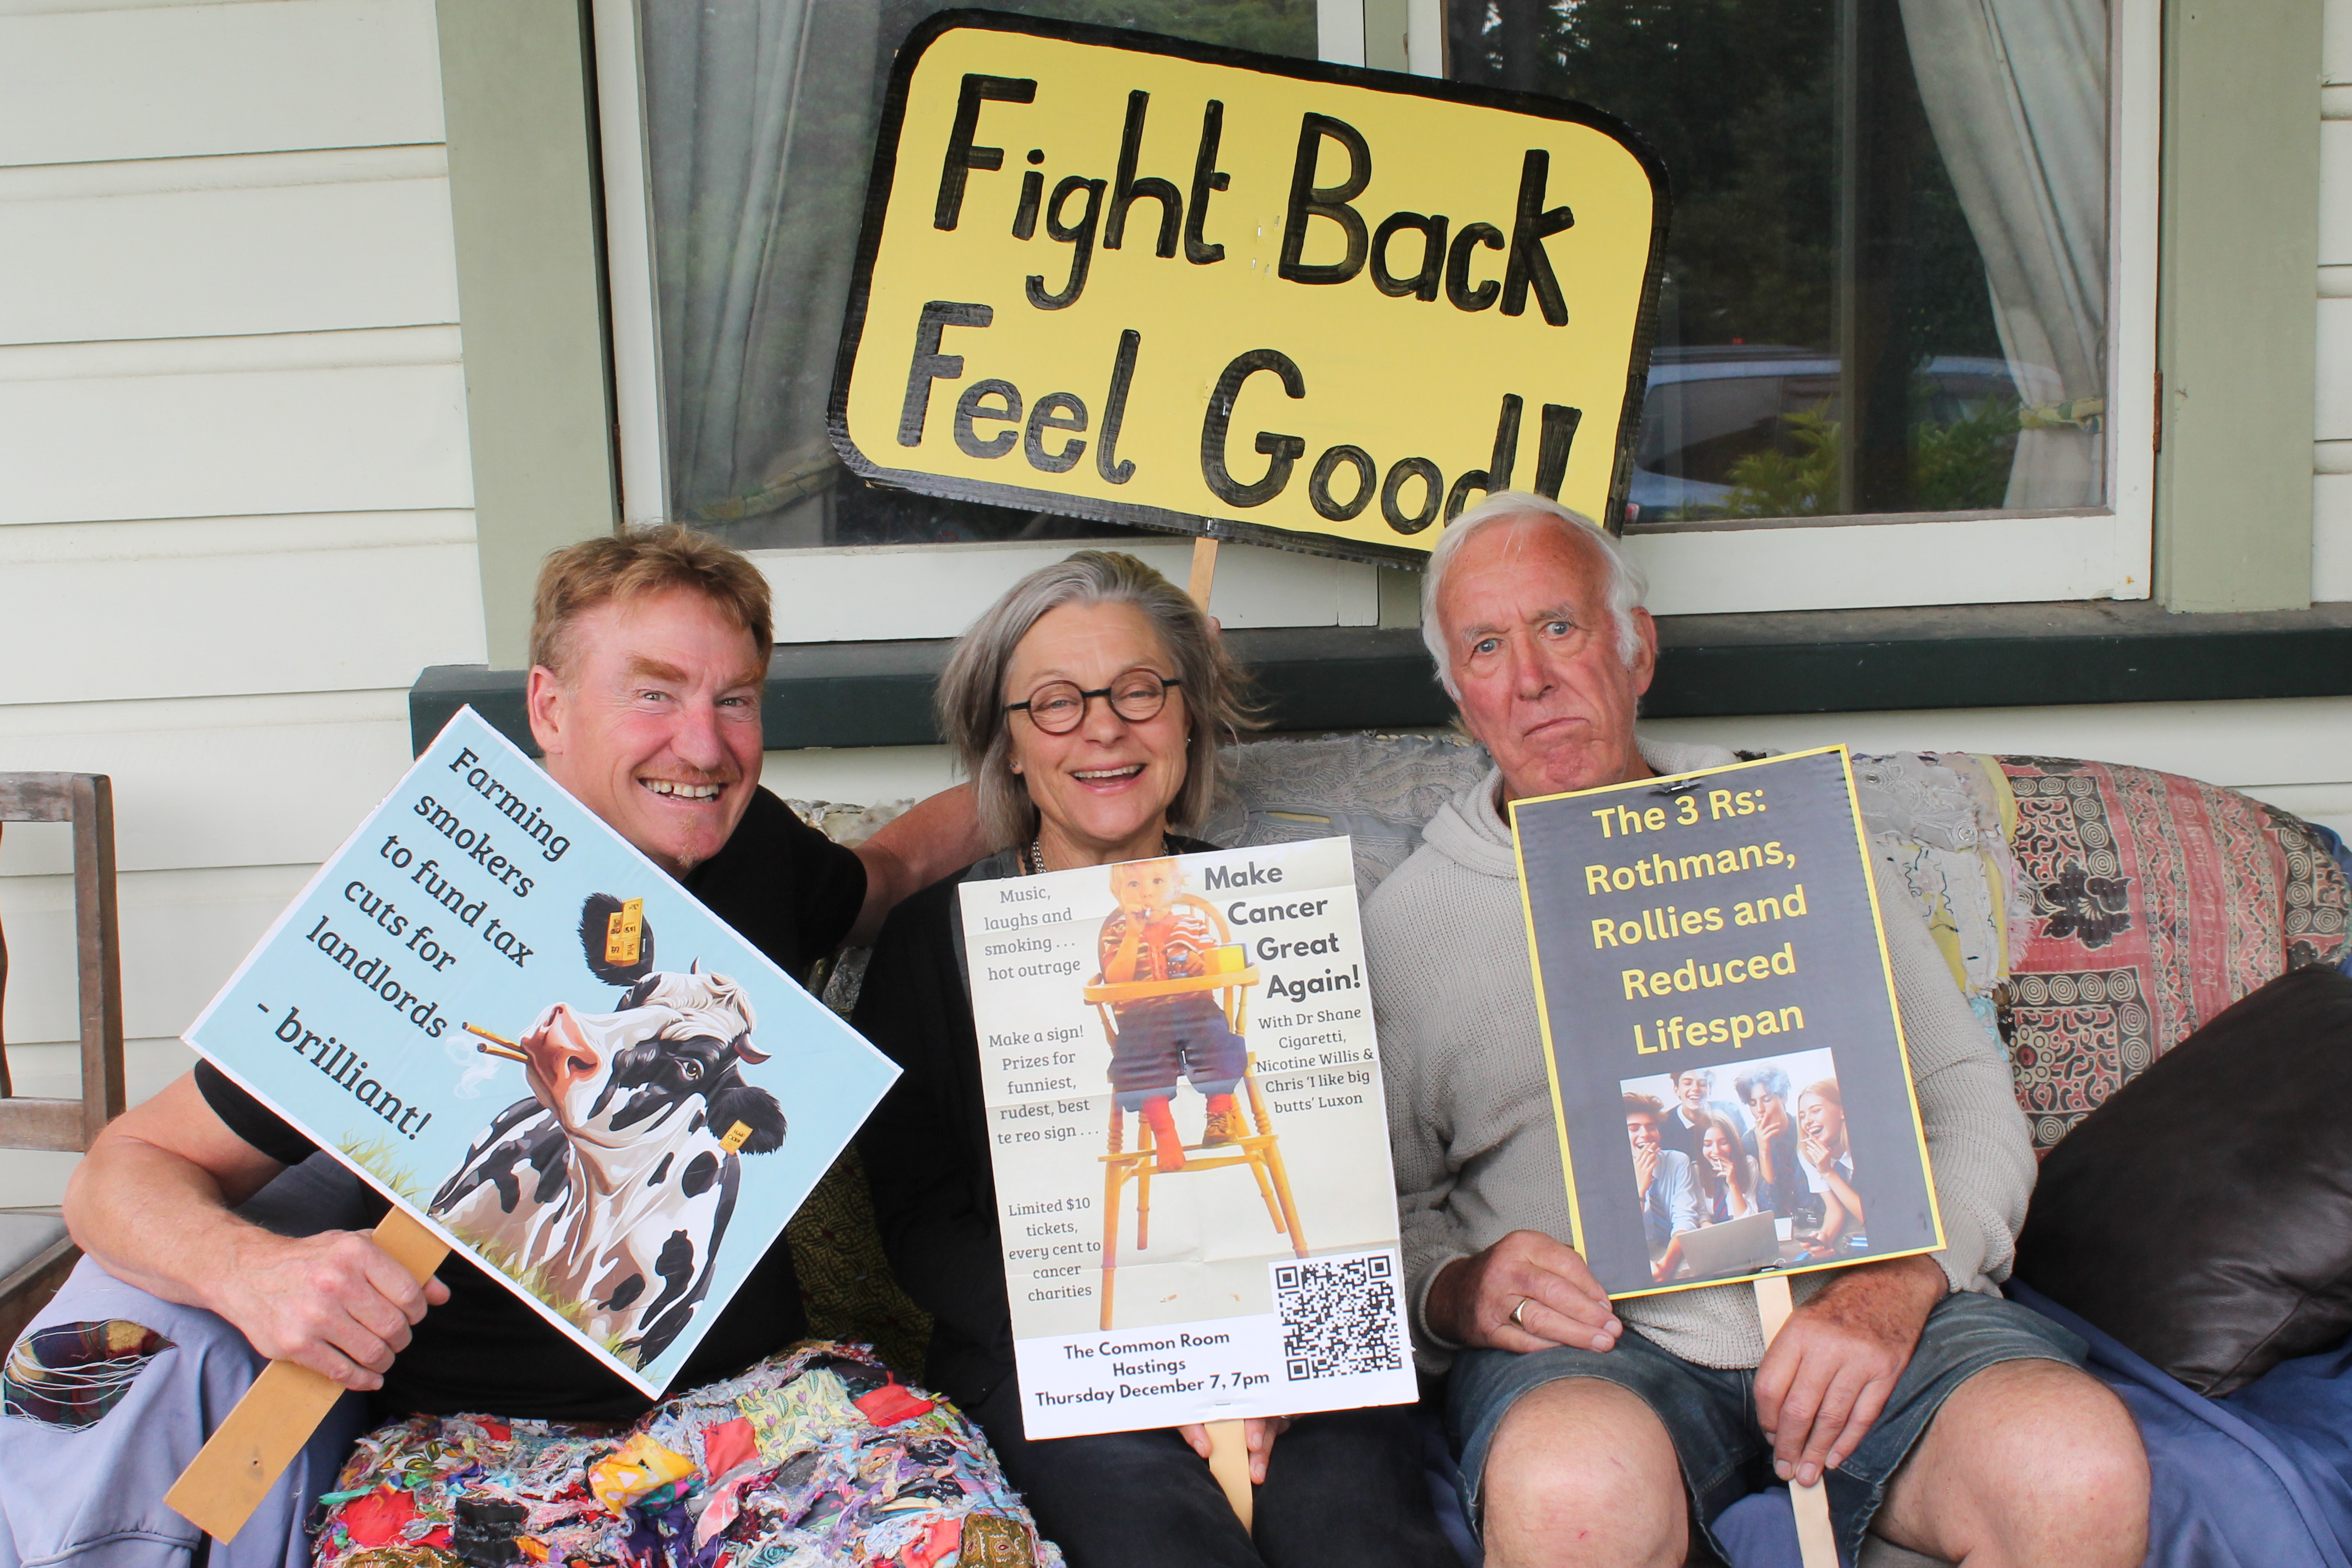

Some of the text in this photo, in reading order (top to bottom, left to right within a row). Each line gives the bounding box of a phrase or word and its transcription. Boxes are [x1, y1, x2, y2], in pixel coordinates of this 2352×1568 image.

[934, 73, 1577, 326] Fight Back
[897, 300, 1140, 484] Feel
[449, 747, 570, 862] Farming
[1591, 789, 1766, 837] The 3 Rs:
[413, 796, 534, 897] smokers
[1205, 862, 1283, 890] Make
[1585, 841, 1795, 895] Rothmans,
[380, 835, 534, 968] to fund tax
[1000, 886, 1050, 903] Music,
[984, 907, 1073, 932] laughs and
[1228, 900, 1328, 925] Cancer
[1591, 884, 1807, 949] Rollies and
[345, 881, 456, 972] cuts for
[985, 938, 1052, 956] smoking
[1257, 933, 1340, 960] Great
[306, 915, 447, 1037] landlords
[987, 961, 1080, 981] hot outrage
[1267, 964, 1360, 1003] Again!
[1622, 943, 1796, 1000] Reduced
[1258, 1009, 1361, 1029] With Dr Shane
[1634, 1006, 1804, 1055] Lifespan
[989, 1025, 1084, 1047] Make a sign!
[1279, 1030, 1346, 1050] Cigaretti,
[275, 1006, 432, 1140] brilliant!
[1002, 1052, 1076, 1070] Prizes for
[1257, 1048, 1374, 1073] Nicotine Willis &
[1008, 1077, 1076, 1095] funniest,
[1265, 1079, 1303, 1093] Chris
[1318, 1074, 1344, 1087] like
[1347, 1070, 1370, 1085] big
[1000, 1099, 1090, 1120] rudest, best
[1319, 1095, 1363, 1108] Luxon
[998, 1132, 1012, 1145] te
[1016, 1130, 1041, 1143] reo
[1044, 1126, 1076, 1142] sign
[1008, 1197, 1090, 1216] Limited $10
[1026, 1223, 1077, 1237] tickets,
[1009, 1242, 1101, 1260] every cent to
[1033, 1265, 1081, 1280] cancer
[1028, 1285, 1092, 1301] charities
[1064, 1333, 1229, 1359] The Common Room
[1113, 1361, 1186, 1376] Hastings
[1035, 1372, 1270, 1406] Thursday December 7, 7pm
